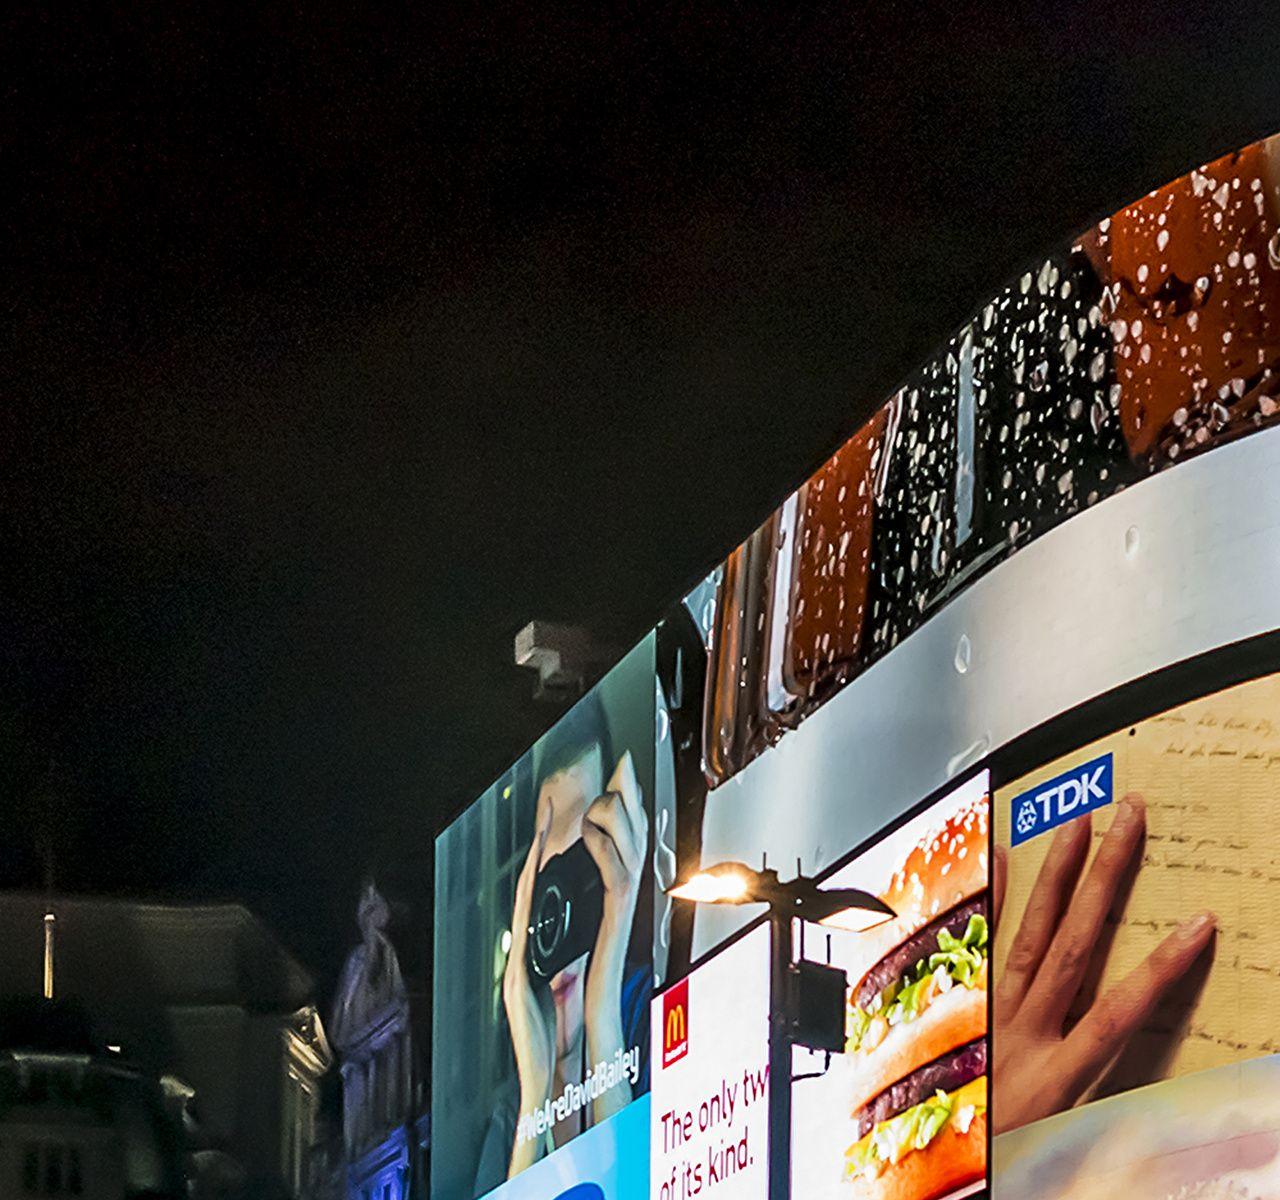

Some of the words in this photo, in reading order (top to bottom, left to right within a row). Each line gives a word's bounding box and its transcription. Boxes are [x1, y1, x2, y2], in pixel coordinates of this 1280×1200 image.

[1035, 765, 1106, 823] TDK
[517, 1046, 640, 1141] #WeAreDavidBailey
[661, 1110, 694, 1154] The
[699, 1079, 739, 1132] only
[743, 1064, 770, 1107] tw
[681, 1160, 703, 1200] its
[708, 1125, 754, 1186] kind.
